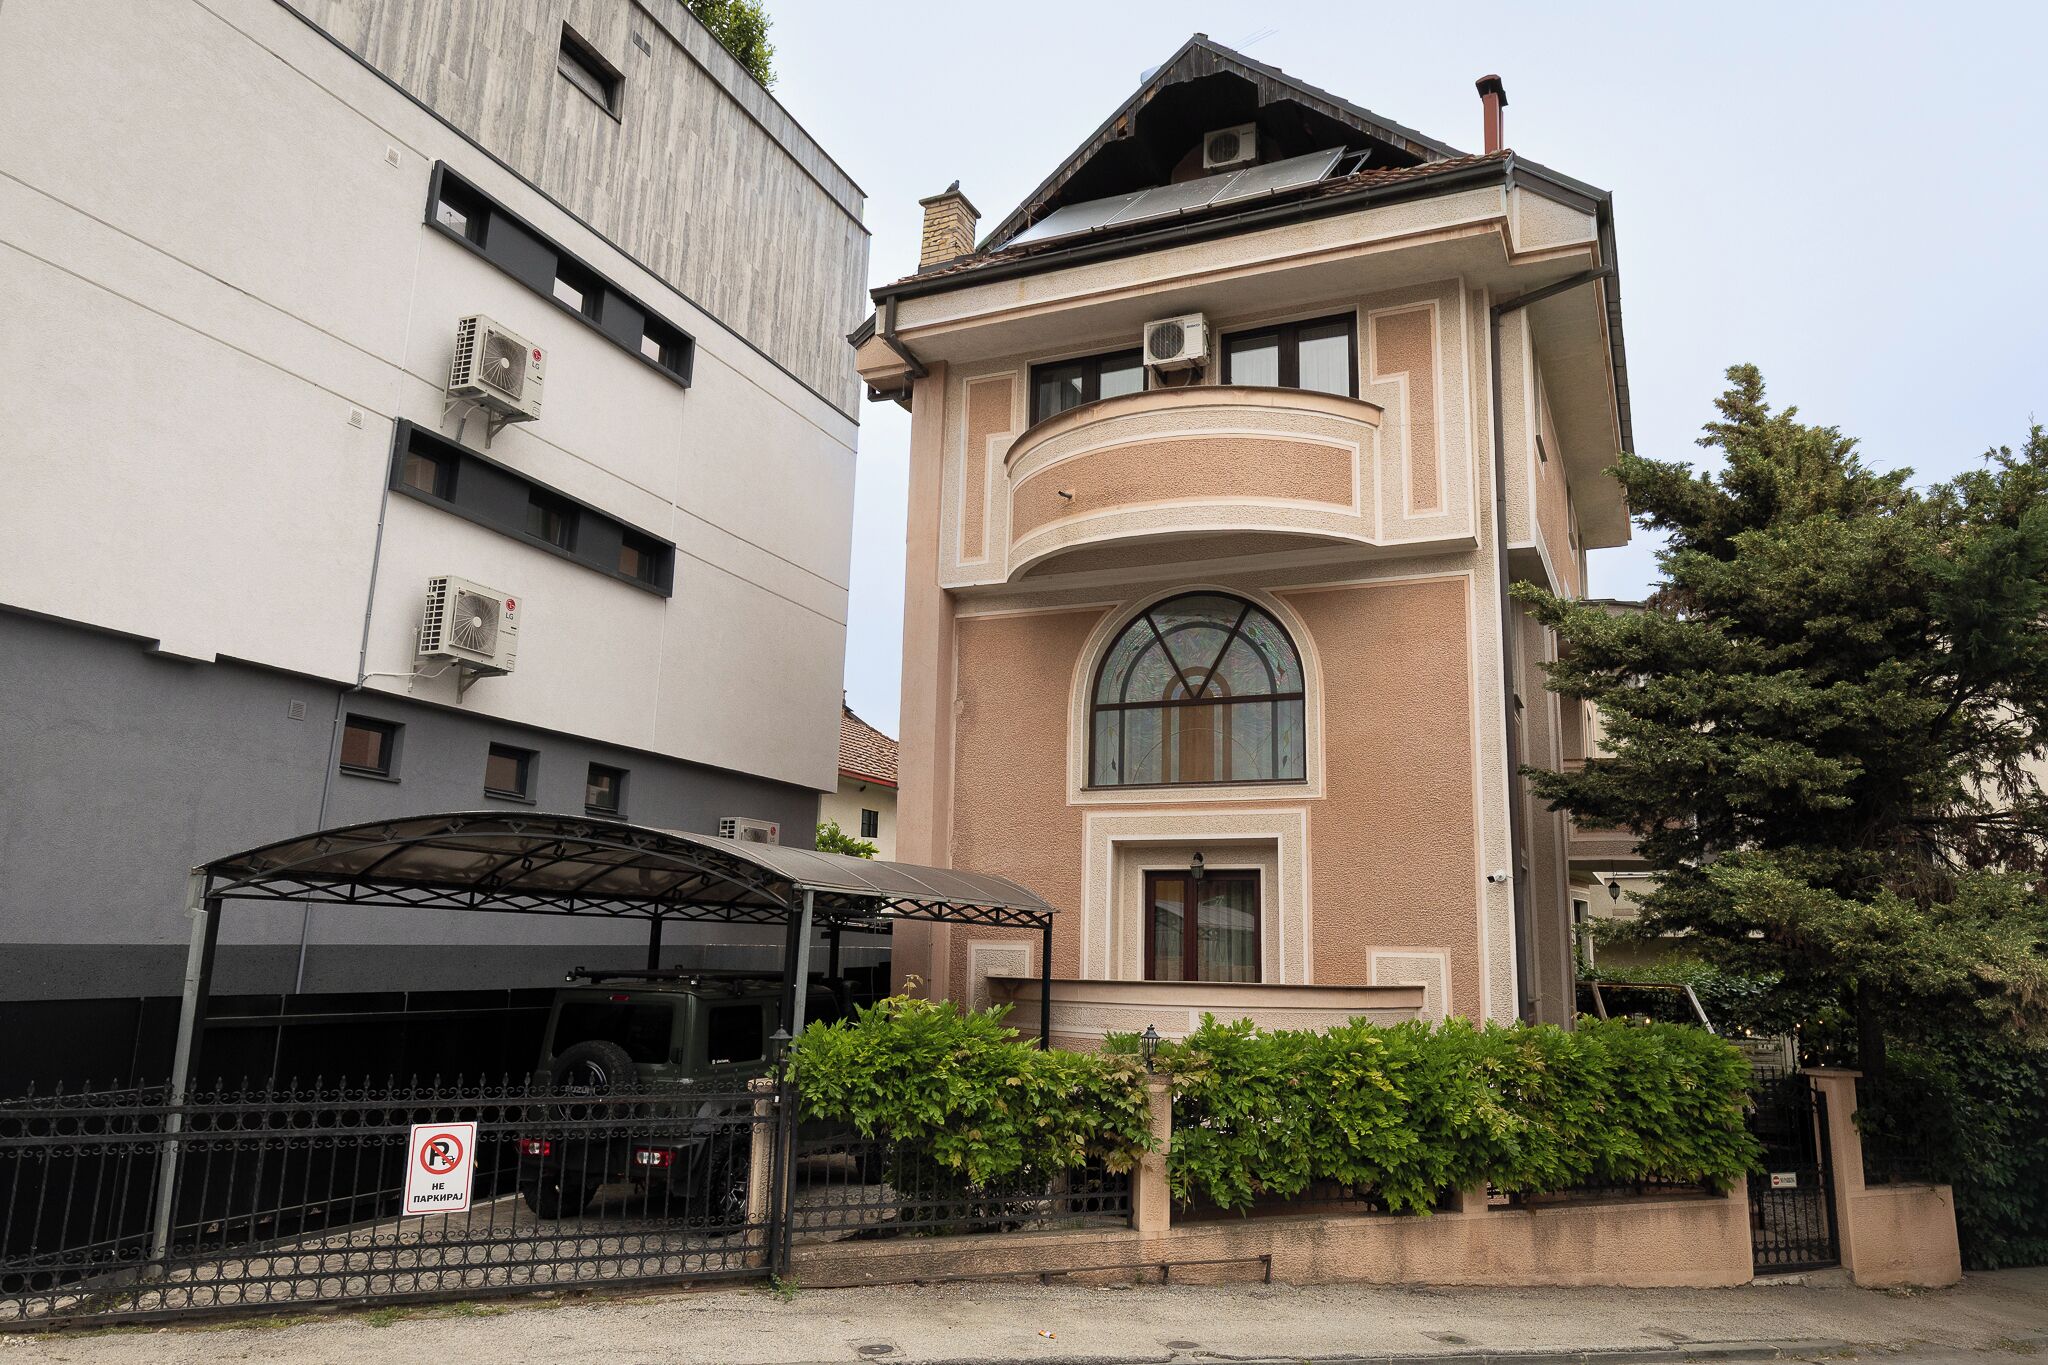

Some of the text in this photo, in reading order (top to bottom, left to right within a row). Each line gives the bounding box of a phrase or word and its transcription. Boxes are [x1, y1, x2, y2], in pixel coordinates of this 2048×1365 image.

[531, 361, 540, 370] LG
[505, 612, 514, 620] LG
[431, 1182, 445, 1191] НЕ
[413, 1192, 463, 1203] ПАРКИРАЈ
